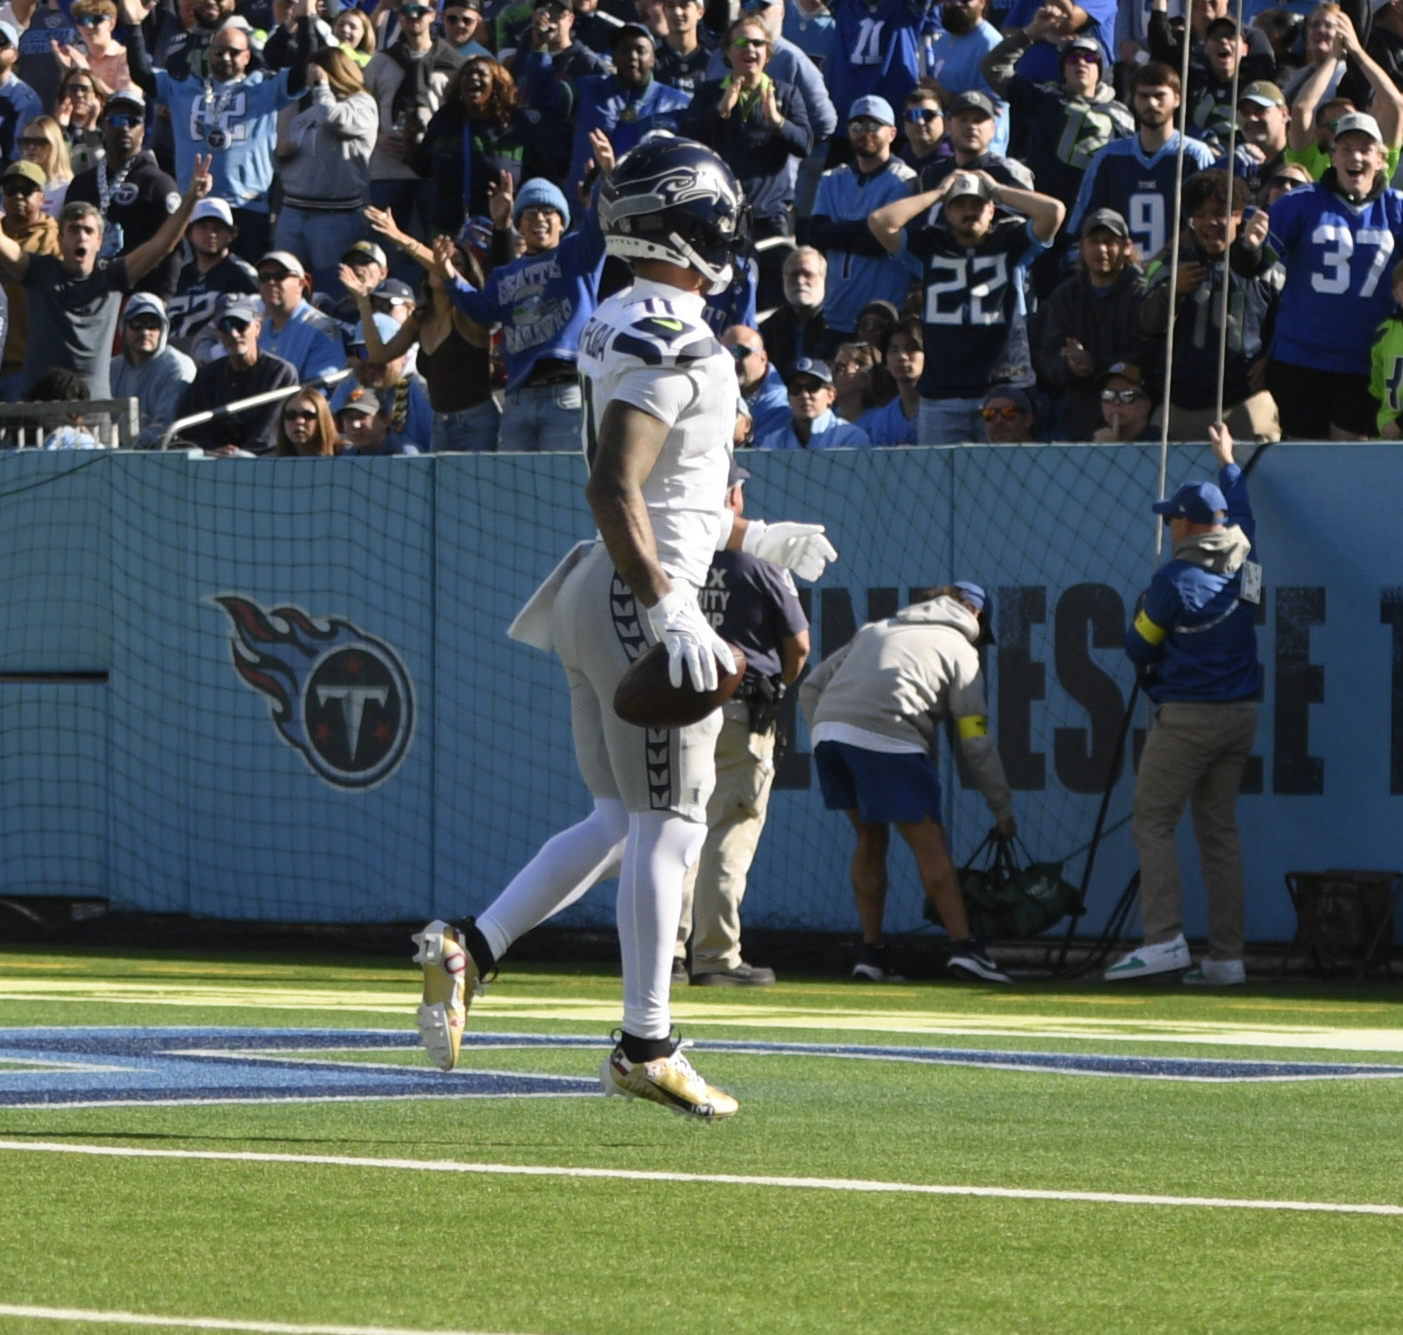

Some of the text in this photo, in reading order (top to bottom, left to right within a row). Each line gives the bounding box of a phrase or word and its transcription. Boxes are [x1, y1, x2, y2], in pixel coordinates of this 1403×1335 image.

[850, 16, 886, 65] 11
[1129, 193, 1166, 262] 9
[1311, 225, 1395, 298] 37
[925, 251, 1010, 326] 22
